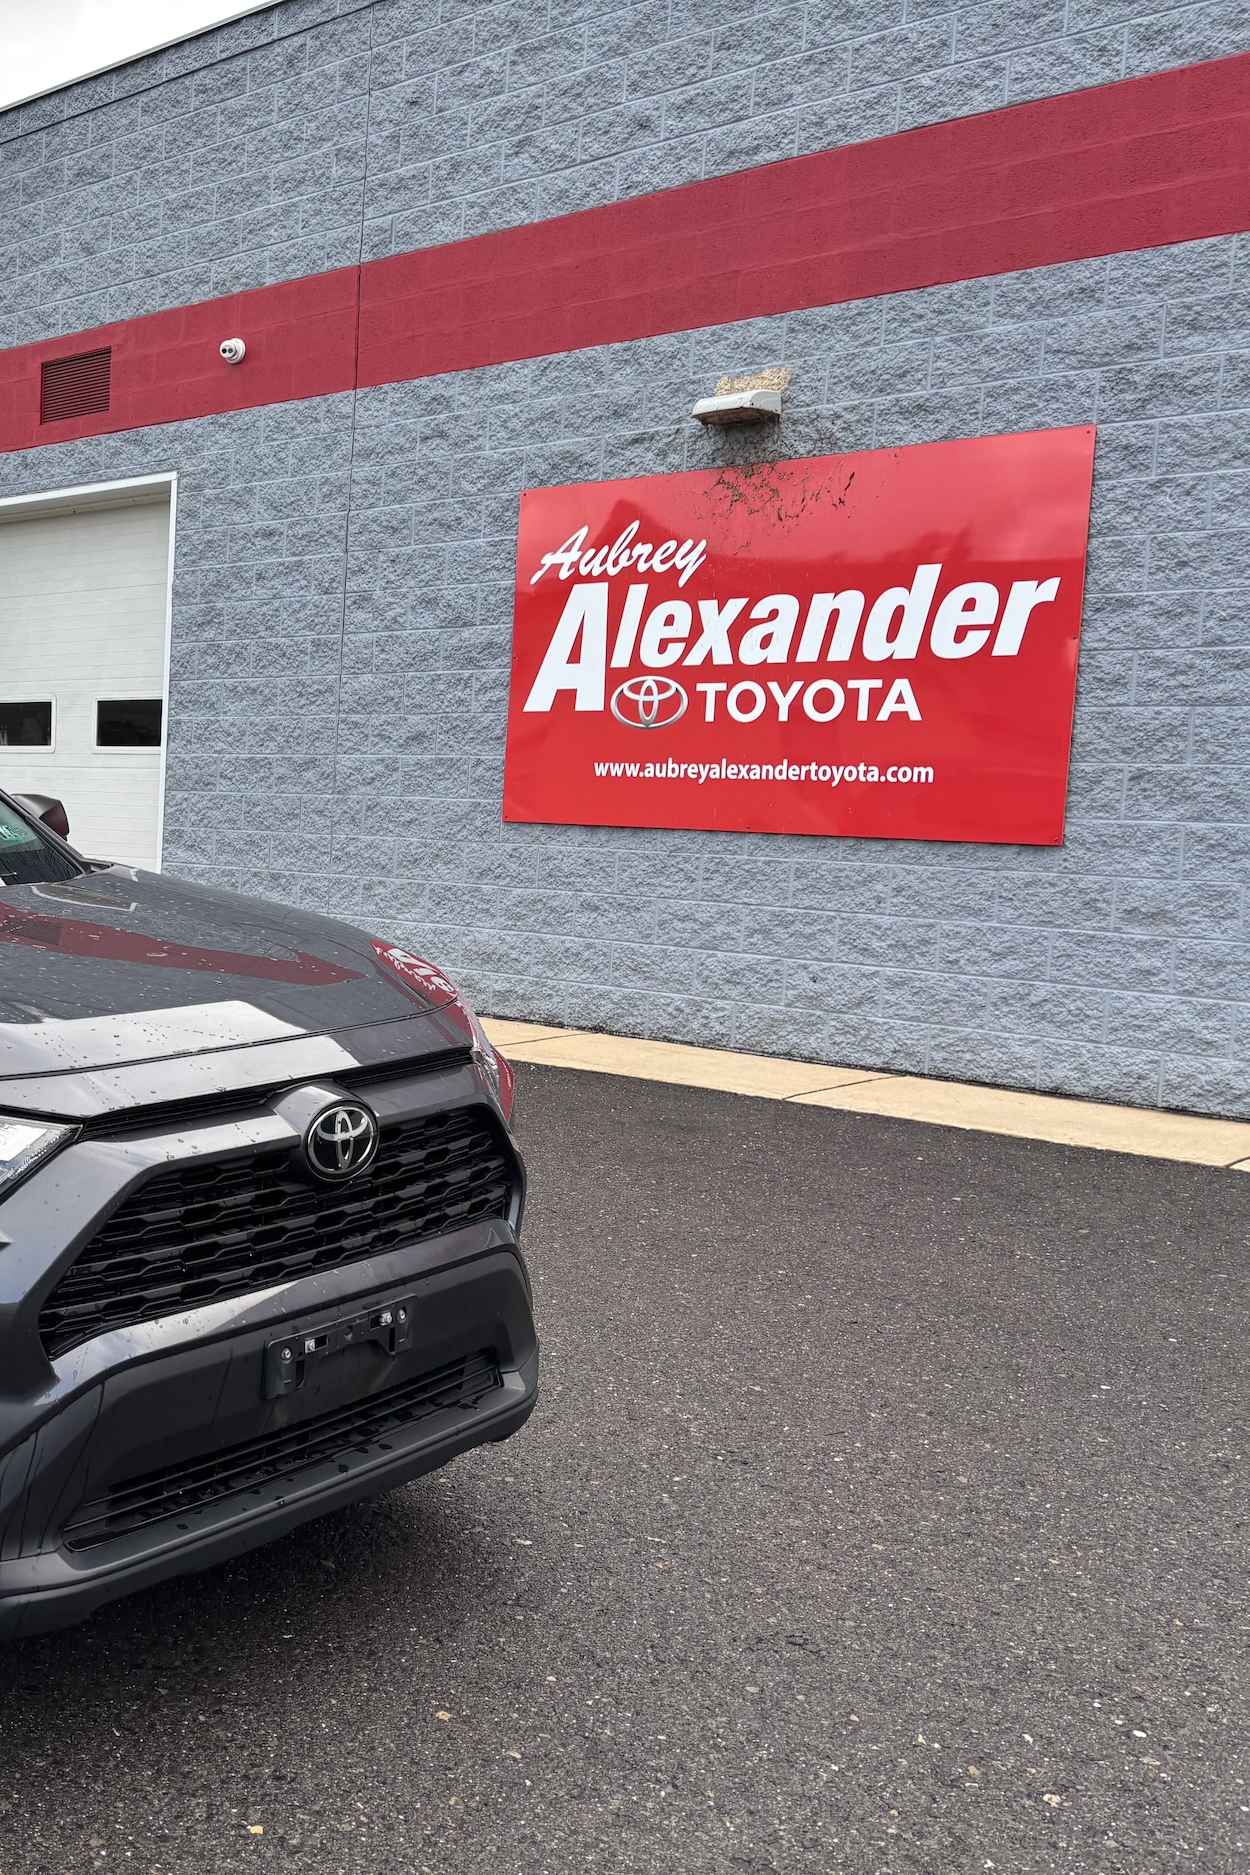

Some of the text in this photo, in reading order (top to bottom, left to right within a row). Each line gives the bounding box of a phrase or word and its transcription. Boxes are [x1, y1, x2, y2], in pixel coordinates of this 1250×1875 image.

[530, 520, 707, 588] Aubrey
[523, 563, 1061, 713] Alexander
[695, 679, 922, 723] TOYOTA
[594, 758, 935, 787] www.aubreyalexandertoyota.com
